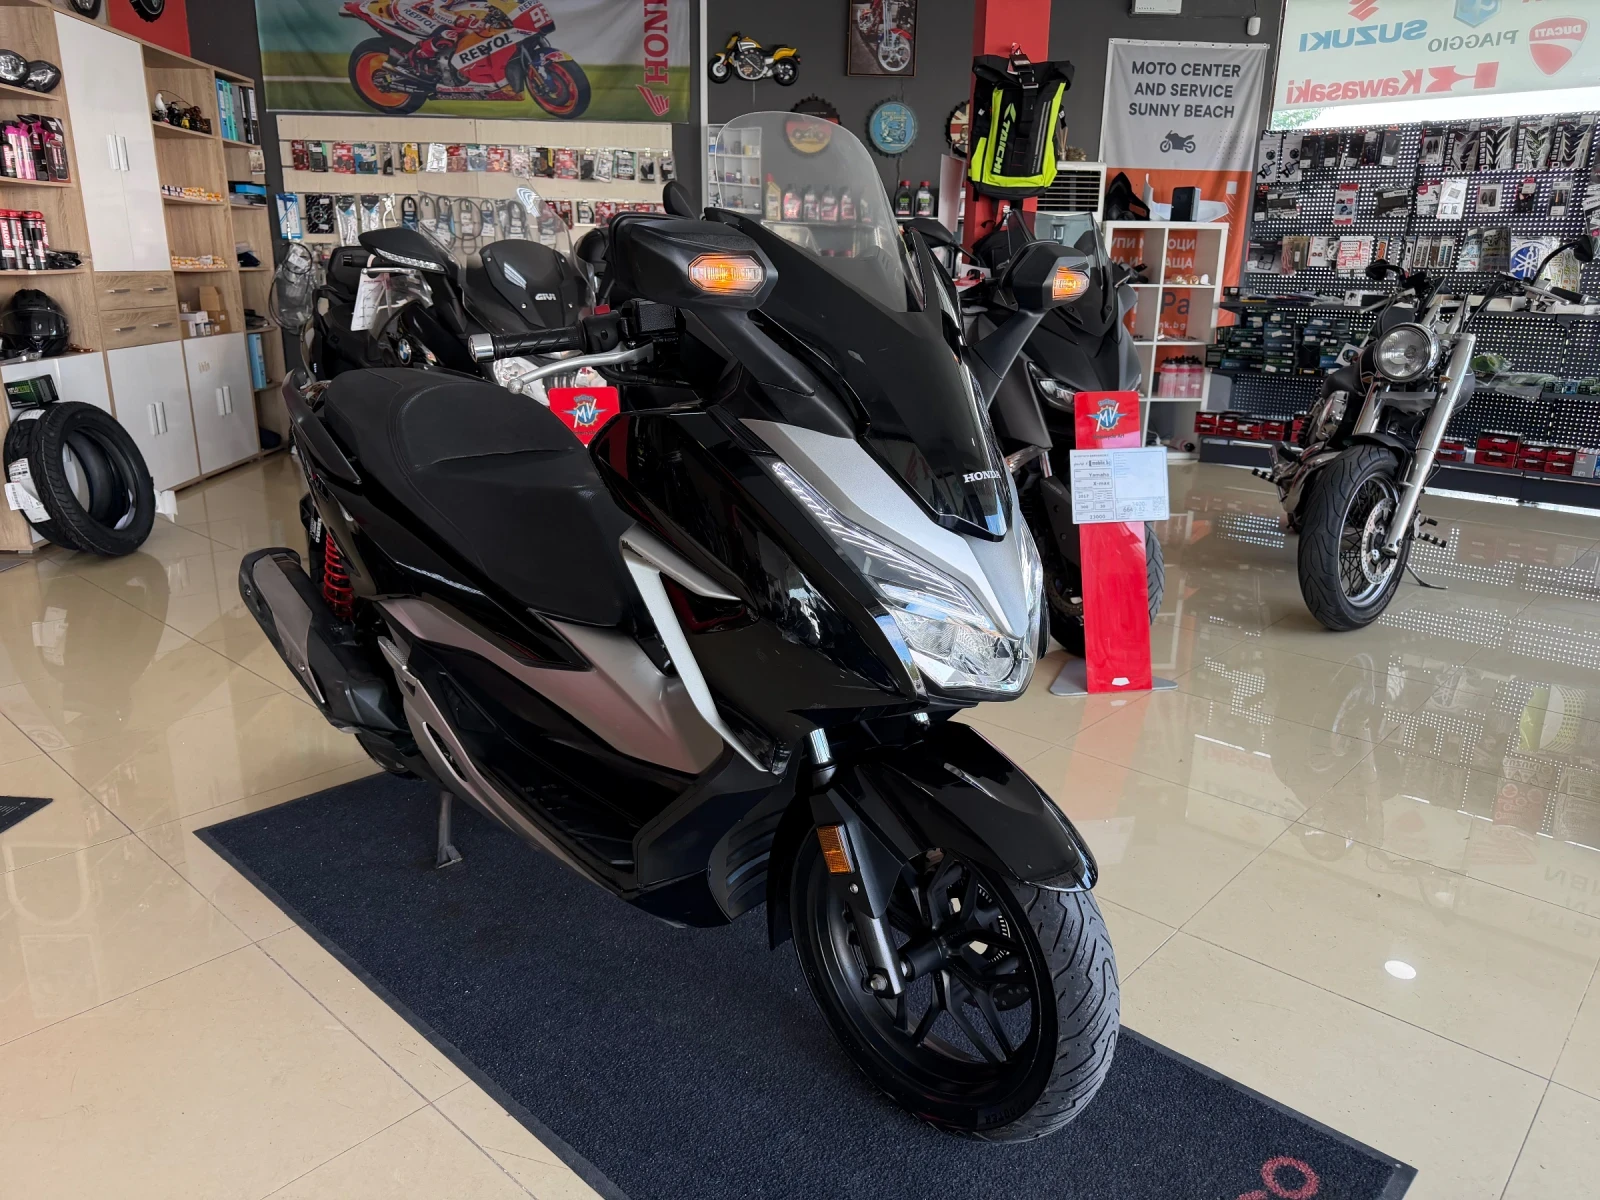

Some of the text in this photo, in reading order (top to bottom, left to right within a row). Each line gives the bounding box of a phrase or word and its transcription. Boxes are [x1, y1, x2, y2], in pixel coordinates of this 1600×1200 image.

[404, 8, 437, 29] REPSOL
[644, 0, 668, 84] HON
[1132, 61, 1241, 77] MOTO CENTER
[1134, 82, 1233, 98] AND SERVICE
[1129, 102, 1235, 118] SUNNY BEACH
[993, 120, 1010, 174] TAICHI
[2, 221, 11, 246] MOTUL
[573, 398, 598, 428] MV
[1095, 402, 1120, 432] MV
[962, 470, 1002, 483] HONDA
